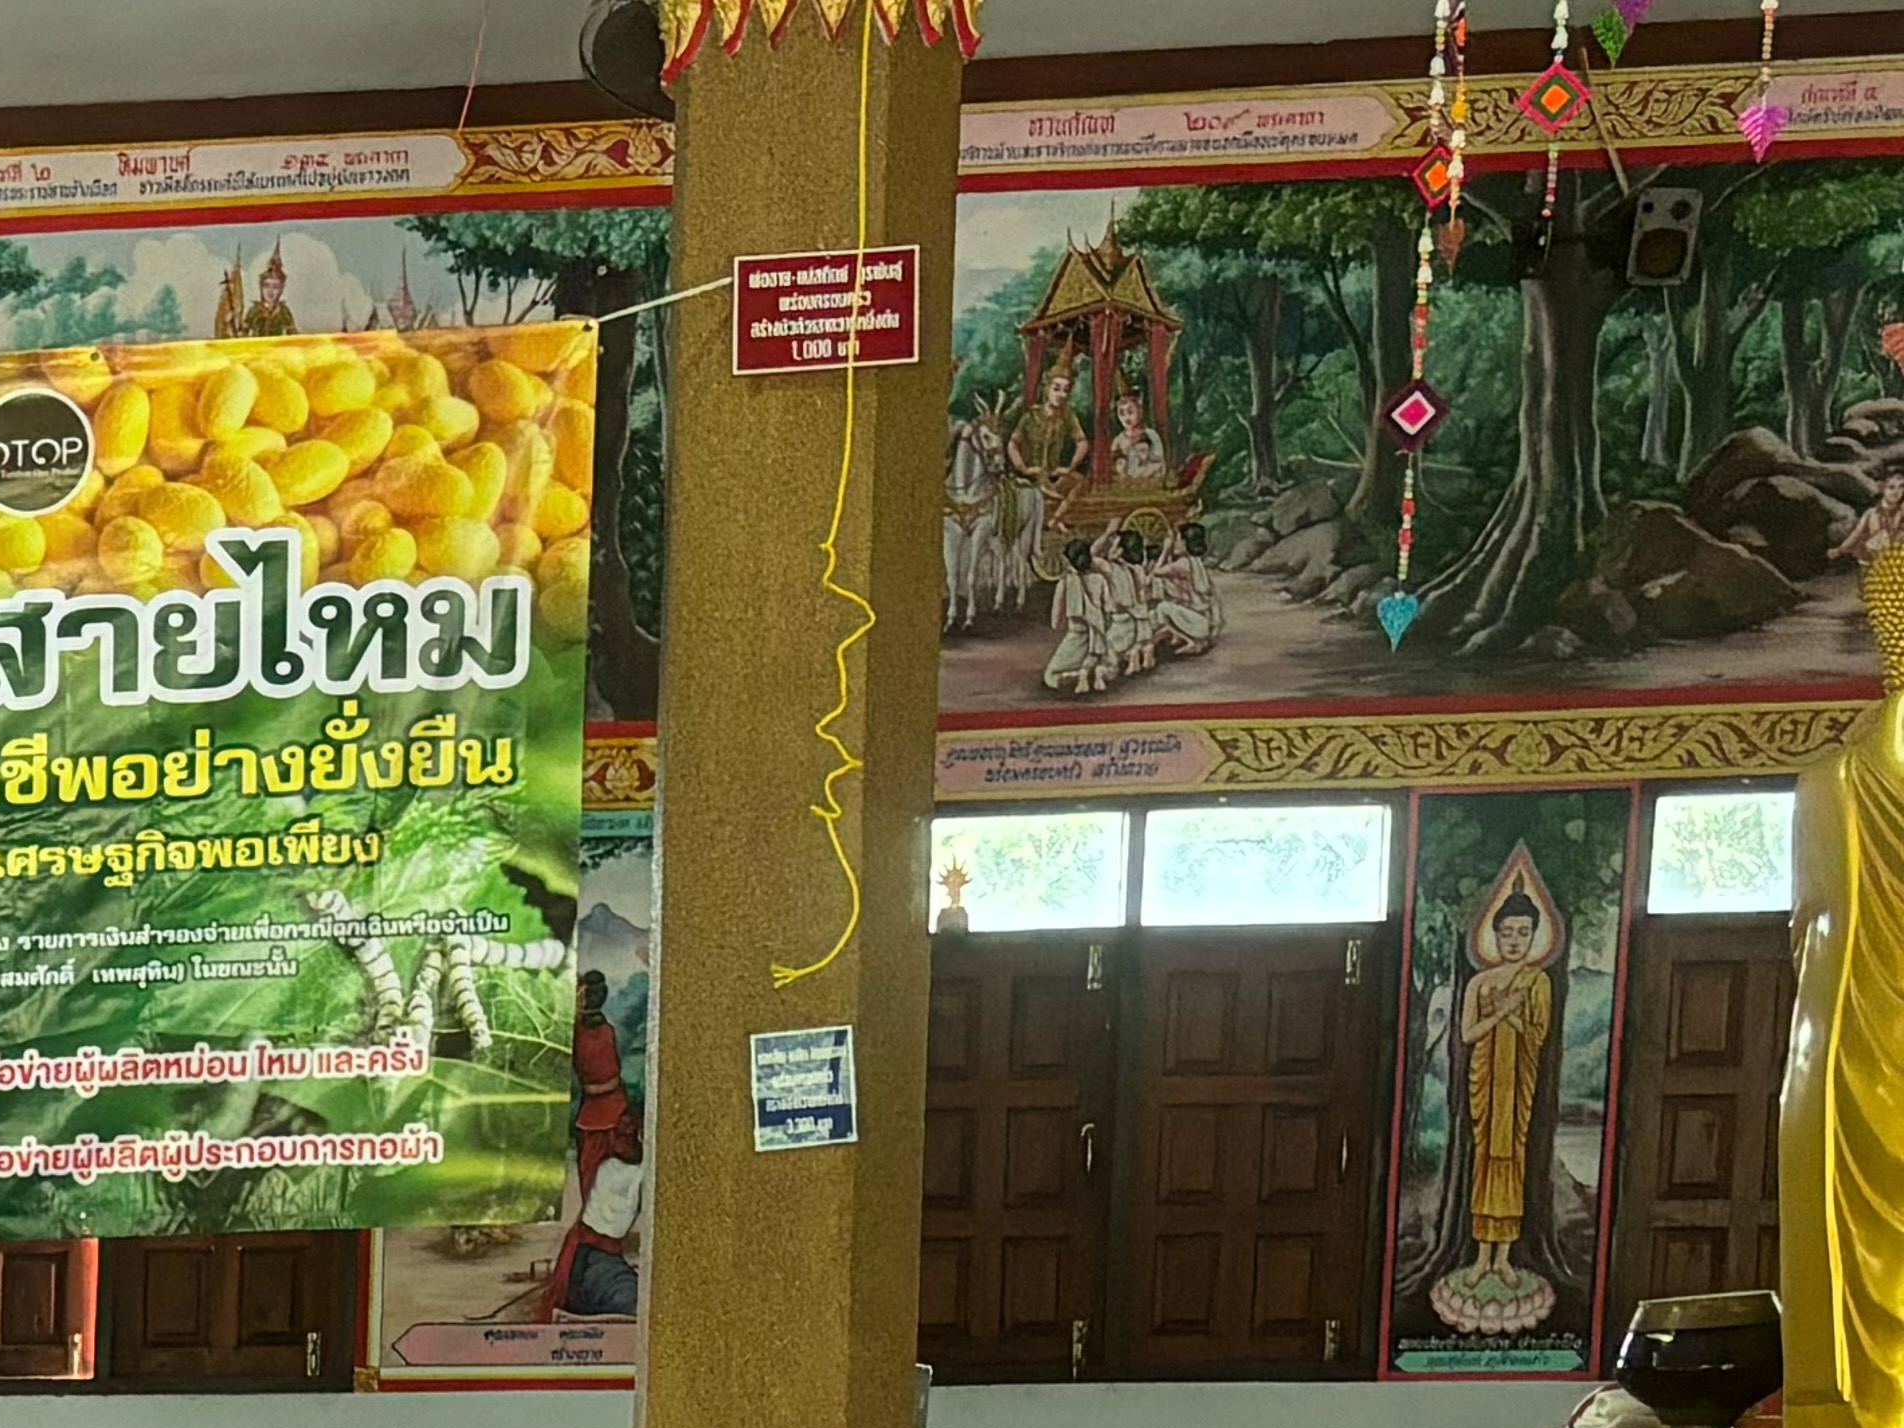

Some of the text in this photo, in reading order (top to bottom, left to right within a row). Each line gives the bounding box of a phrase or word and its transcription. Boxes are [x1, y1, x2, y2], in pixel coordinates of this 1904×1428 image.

[92, 959, 186, 990] เทพสุทิน)
[191, 946, 298, 979] ในขณะนั้น
